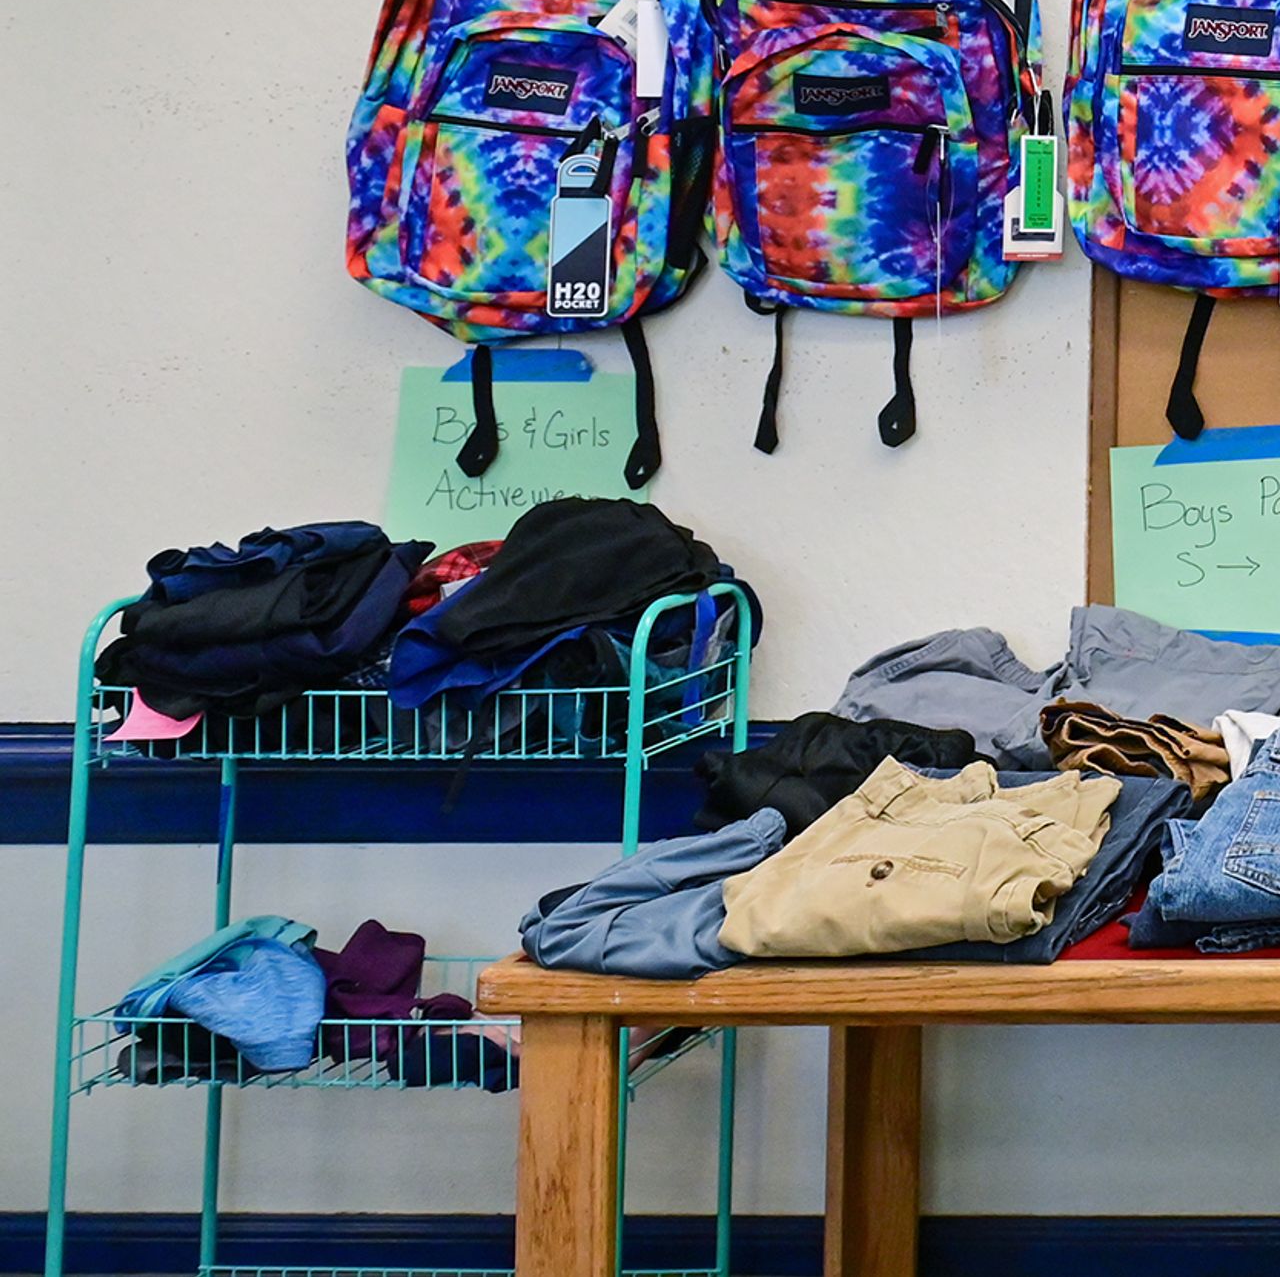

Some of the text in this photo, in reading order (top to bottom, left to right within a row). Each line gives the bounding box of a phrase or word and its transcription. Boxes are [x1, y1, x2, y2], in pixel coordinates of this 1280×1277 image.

[1188, 17, 1269, 42] JANSPORT
[488, 74, 569, 100] JANSPORT
[554, 299, 600, 310] POCKET
[542, 409, 611, 452] Girls
[1140, 482, 1234, 550] Boys
[1175, 551, 1206, 588] S
